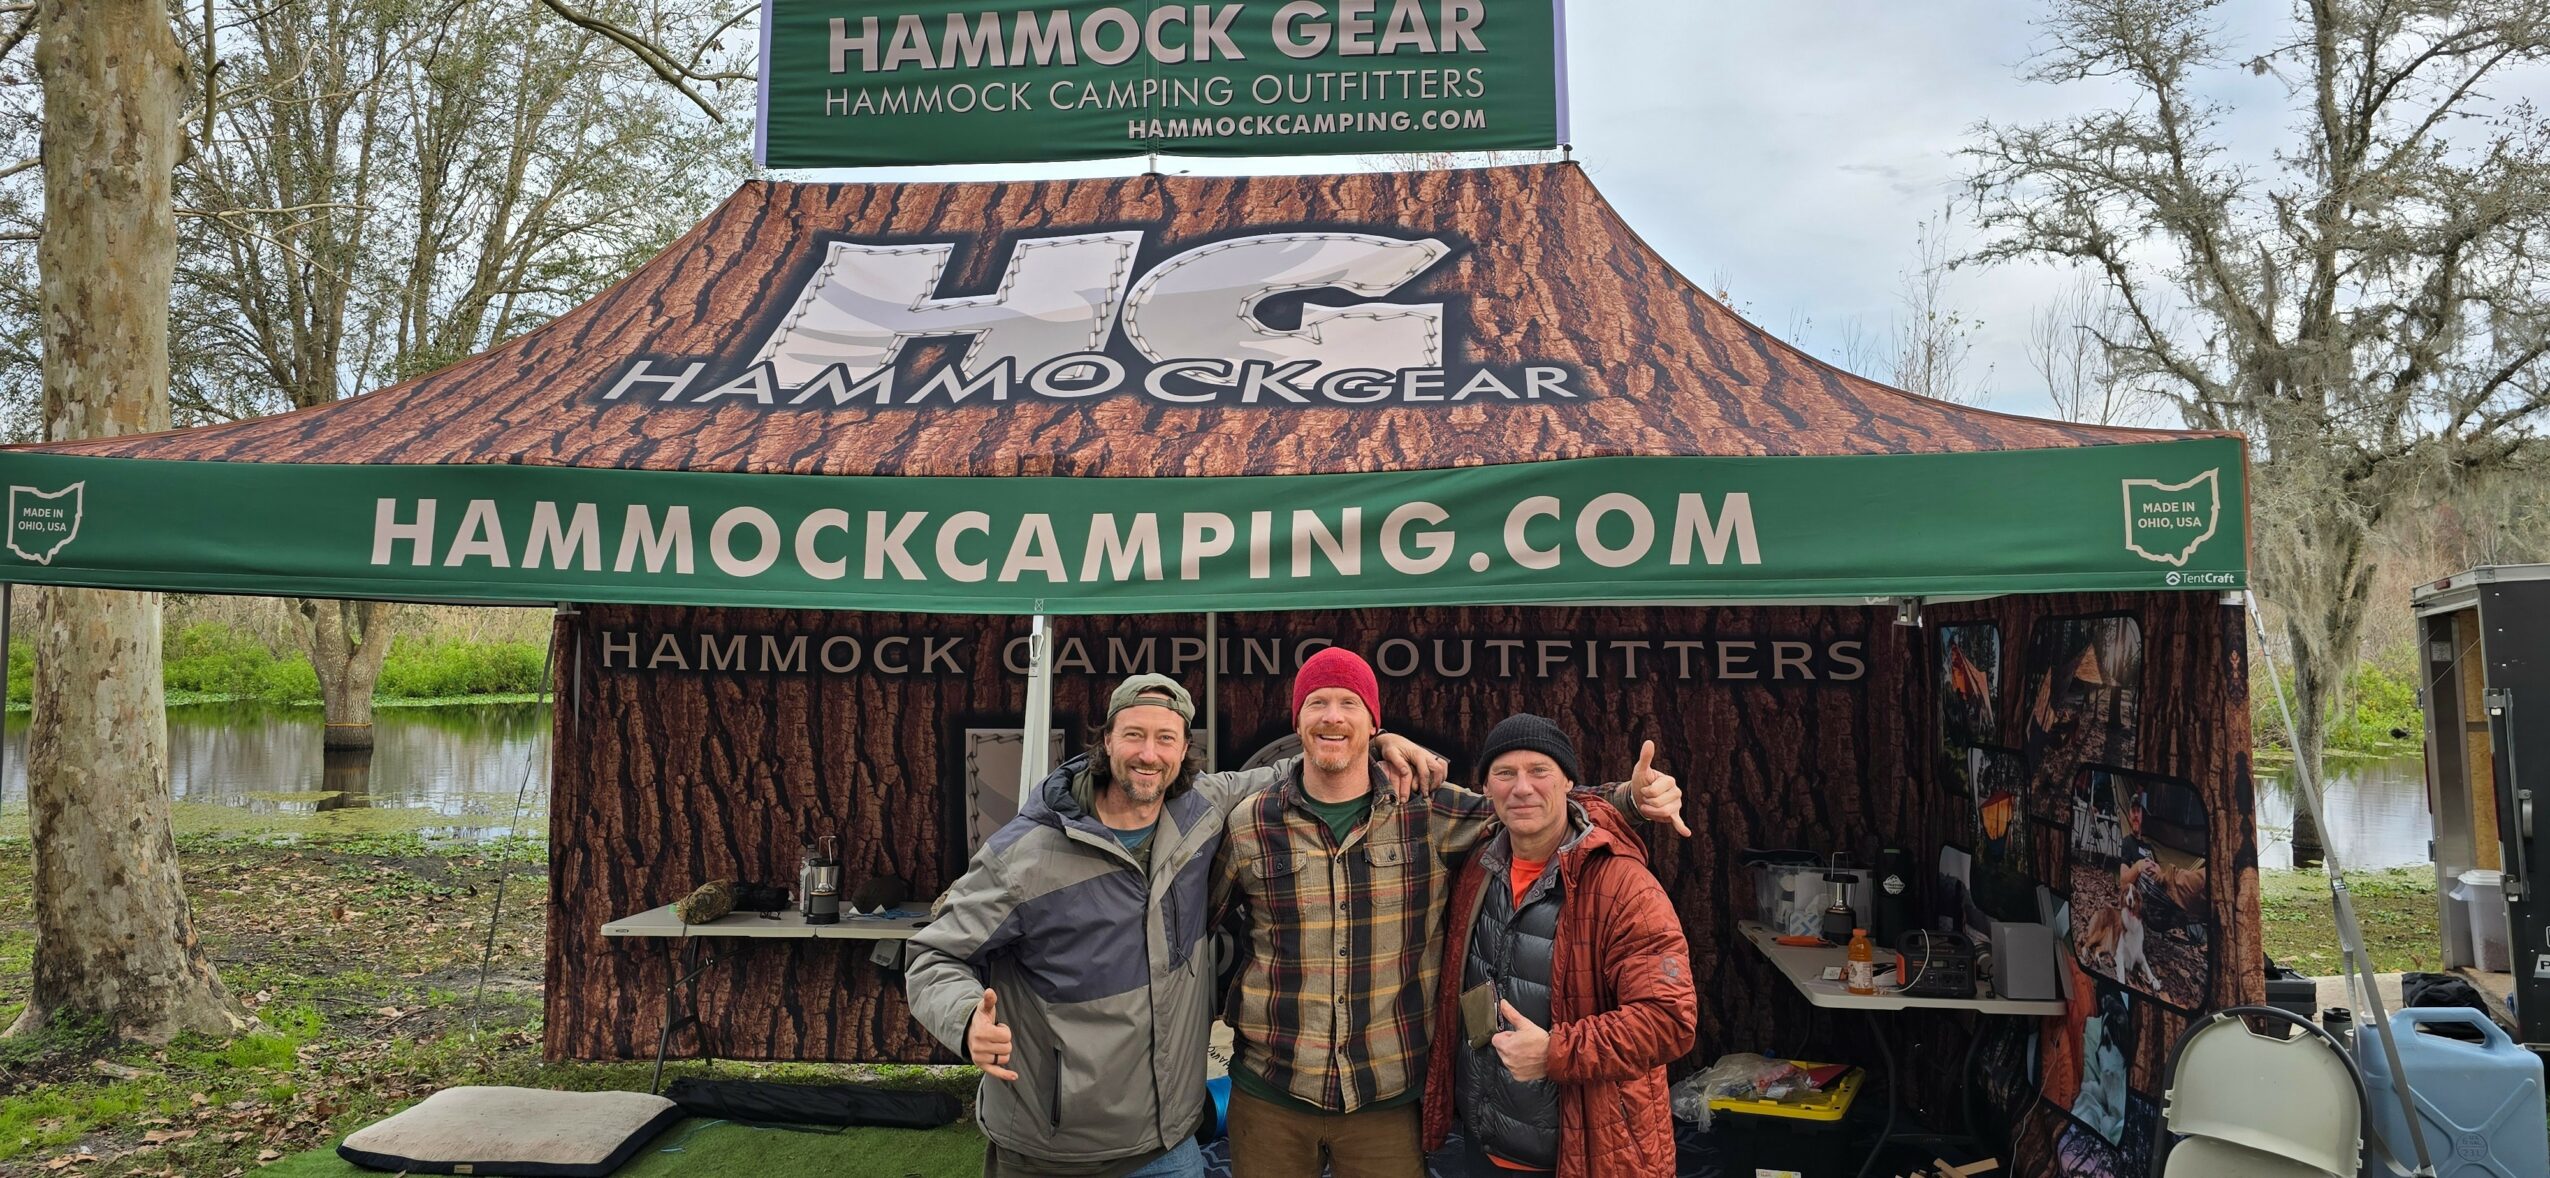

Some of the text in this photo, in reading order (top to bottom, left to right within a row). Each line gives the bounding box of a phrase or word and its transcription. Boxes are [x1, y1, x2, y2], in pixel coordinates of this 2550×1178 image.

[828, 0, 1487, 73] HAMMOCK GEAR
[826, 67, 1486, 116] HAMMOCK CAMPING OUTFITTERS
[1128, 109, 1487, 139] HAMMOCKCAMPING.COM
[748, 230, 1452, 389] HG
[23, 507, 63, 518] MADE IN
[2142, 501, 2195, 514] MADE IN
[18, 520, 67, 532] OHIO, USA
[370, 491, 1763, 583] HAMMOCKCAMPING.COM
[2137, 516, 2202, 530] OHIO, USA
[2181, 572, 2235, 584] TentCraft
[602, 631, 966, 674] HAMMOCK
[1376, 637, 1866, 681] OUTFITTERS
